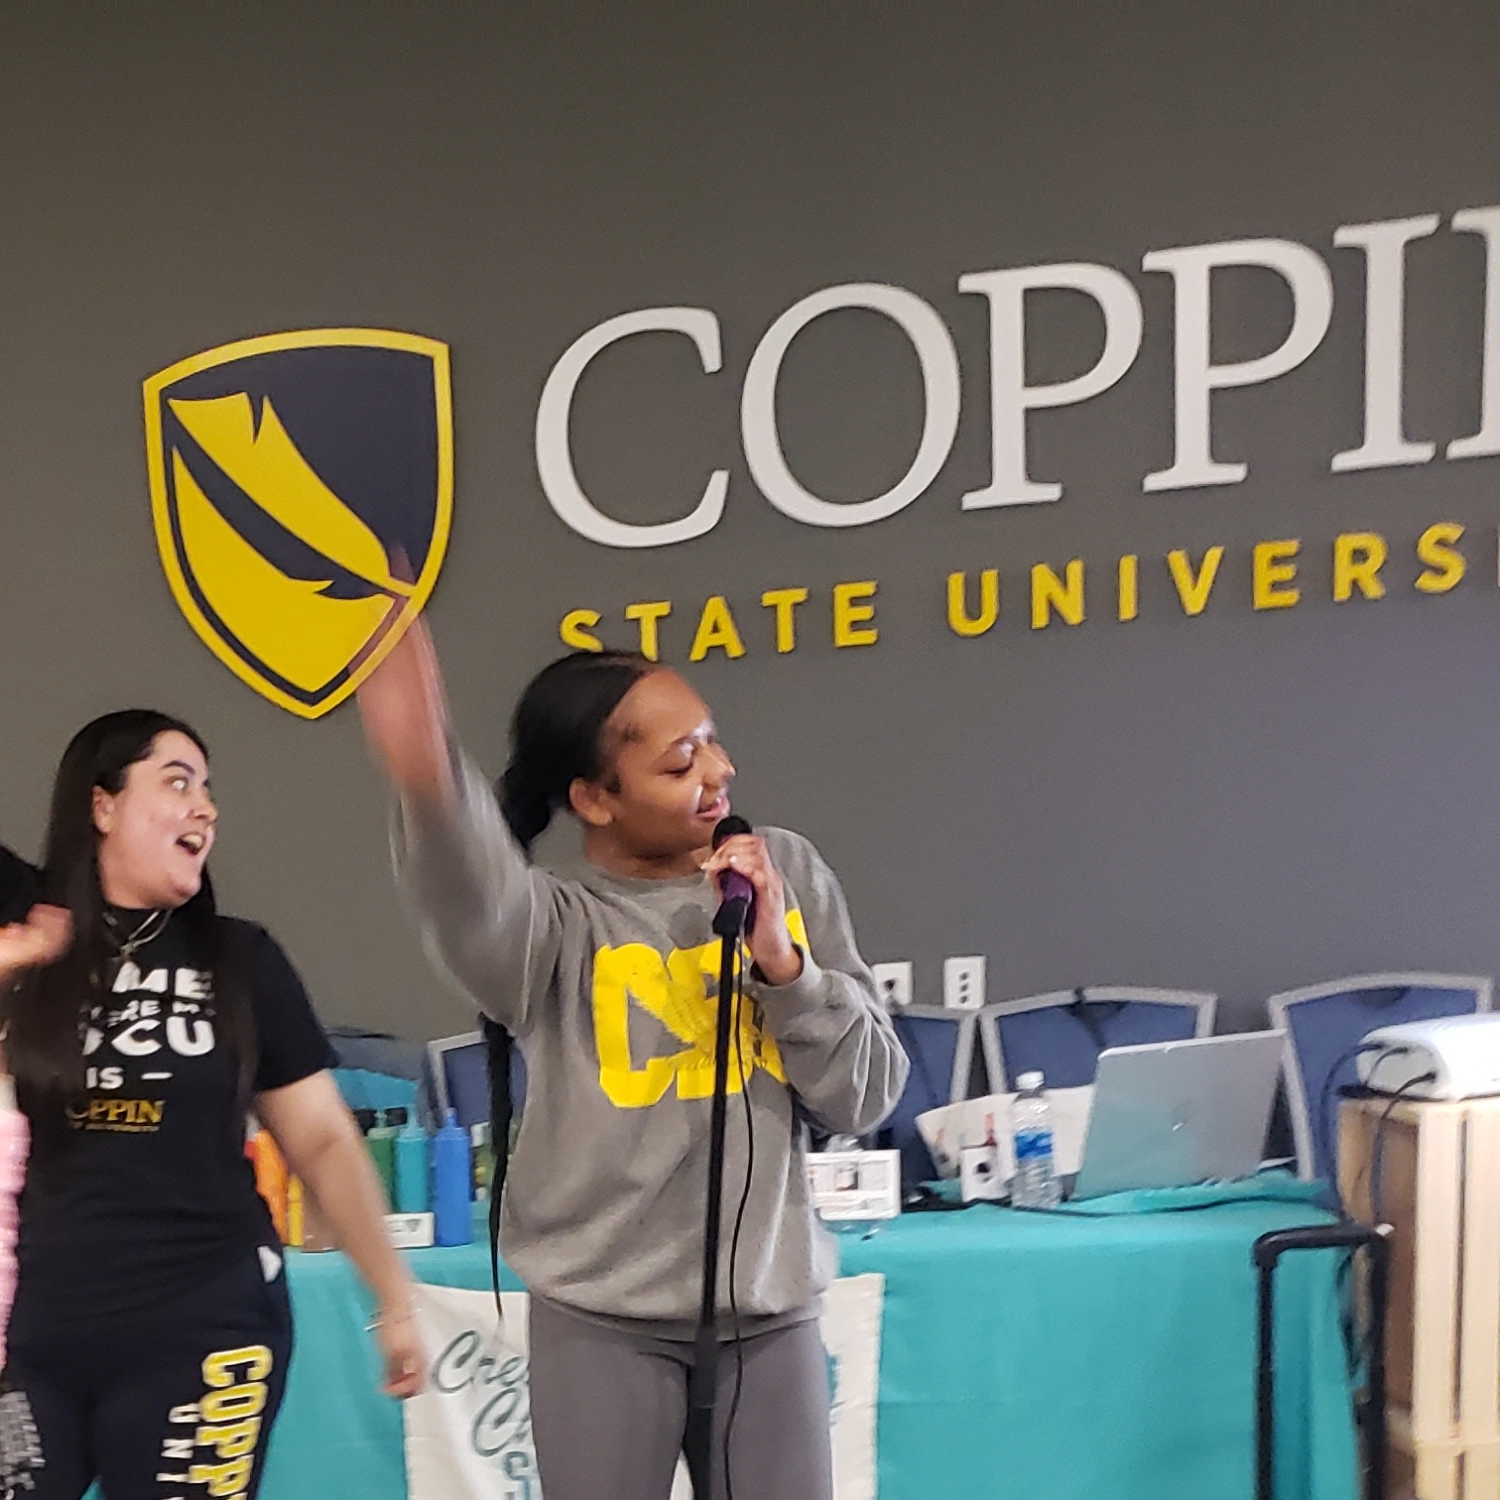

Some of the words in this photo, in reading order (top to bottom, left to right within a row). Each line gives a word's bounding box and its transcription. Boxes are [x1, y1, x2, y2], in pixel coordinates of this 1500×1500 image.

[558, 580, 879, 663] STATE
[946, 521, 1500, 638] UNIVERS
[111, 960, 216, 1000] ME
[592, 908, 812, 1109] CS
[76, 1016, 216, 1057] CU
[85, 1066, 125, 1090] IS
[65, 1099, 165, 1124] PPIN
